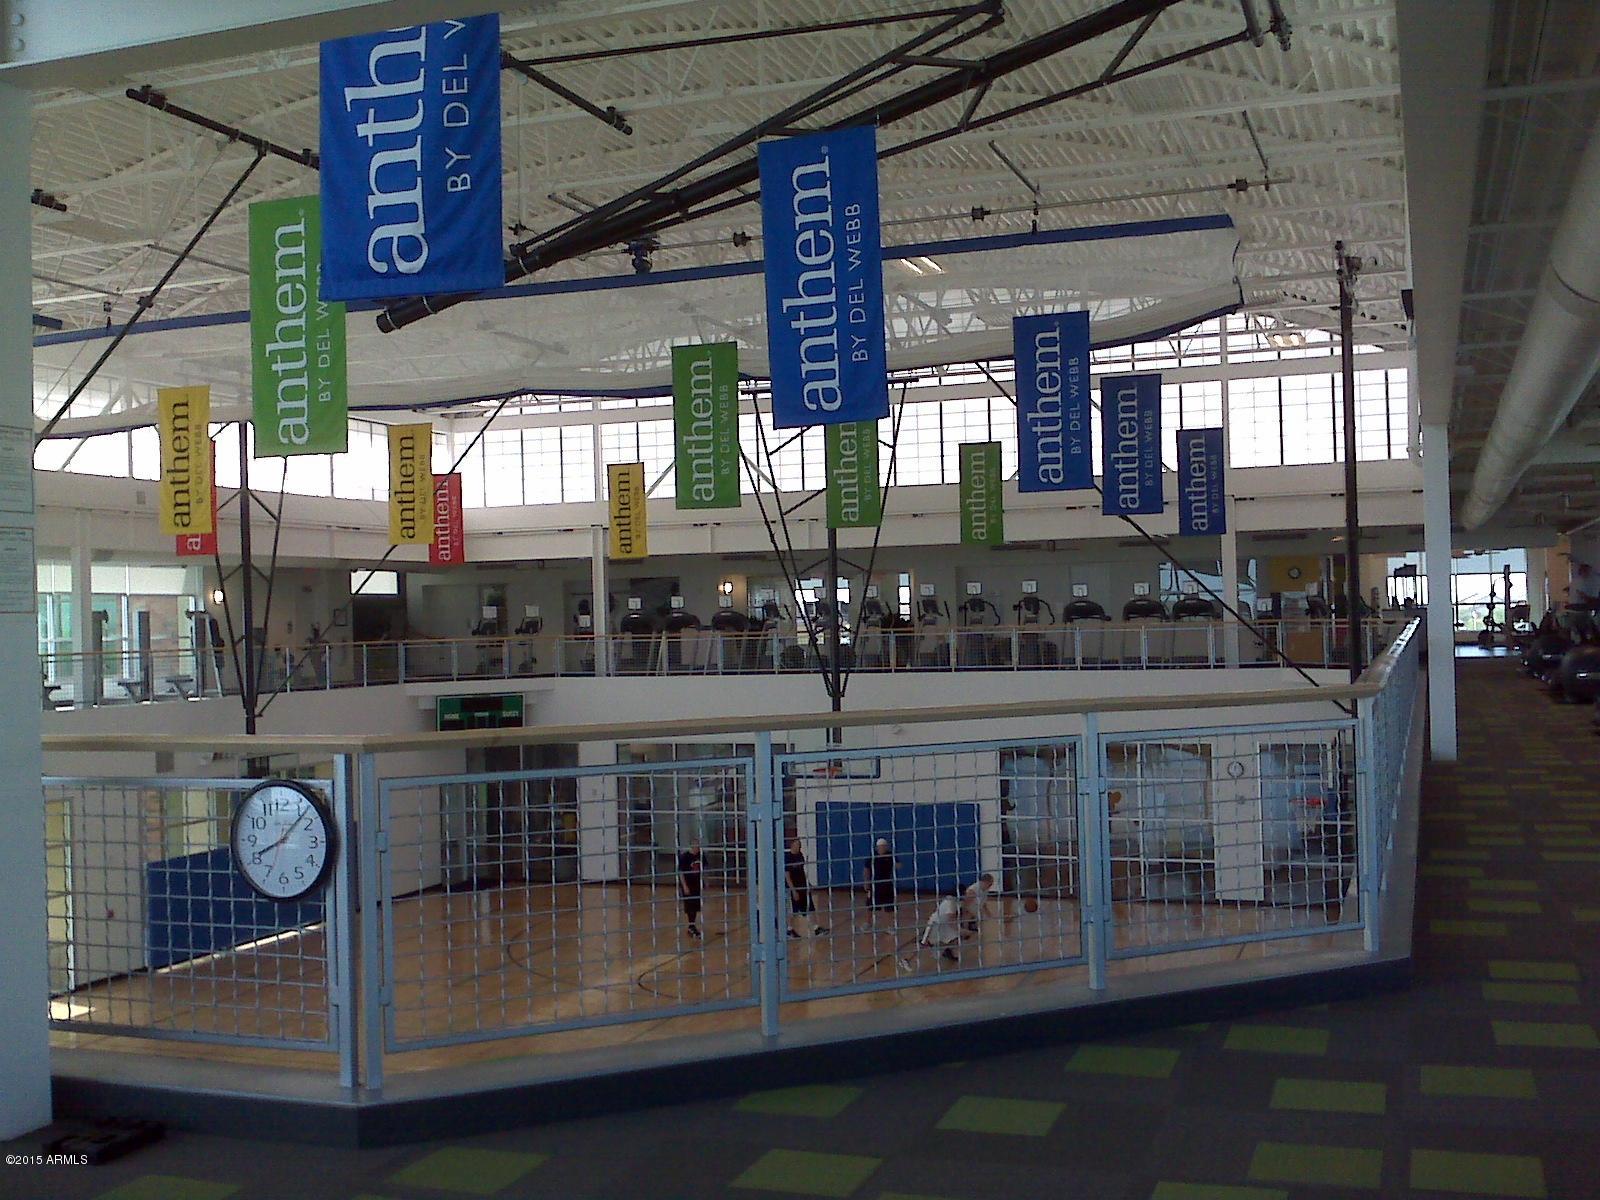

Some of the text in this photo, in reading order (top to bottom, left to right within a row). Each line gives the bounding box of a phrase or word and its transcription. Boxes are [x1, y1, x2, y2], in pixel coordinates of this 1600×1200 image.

[442, 54, 469, 127] DEL
[344, 26, 428, 274] anth
[445, 147, 471, 192] BY
[782, 155, 843, 412] anthem
[844, 203, 868, 361] BY DEL WEBB
[266, 217, 310, 445] anthem
[317, 328, 331, 368] DEL
[319, 378, 331, 402] BY
[1027, 326, 1064, 484] anthem
[1068, 357, 1081, 454] BY DEL WEBB
[167, 401, 191, 528] anthem
[683, 358, 715, 501] anthem
[719, 384, 730, 475] BY DEL WEBB
[1111, 387, 1139, 509] anthem
[395, 436, 416, 539] anthem
[614, 471, 632, 553] anthem
[967, 452, 987, 540] anthem
[1185, 437, 1208, 531] anthem
[248, 834, 257, 847] 9
[251, 817, 266, 830] 10
[263, 803, 273, 816] 11
[276, 798, 289, 811] 12
[304, 817, 313, 831] 2
[309, 836, 318, 849] 3
[264, 864, 273, 877] 7
[279, 872, 289, 884] 6
[294, 866, 304, 879] 5
[306, 854, 315, 867] 4
